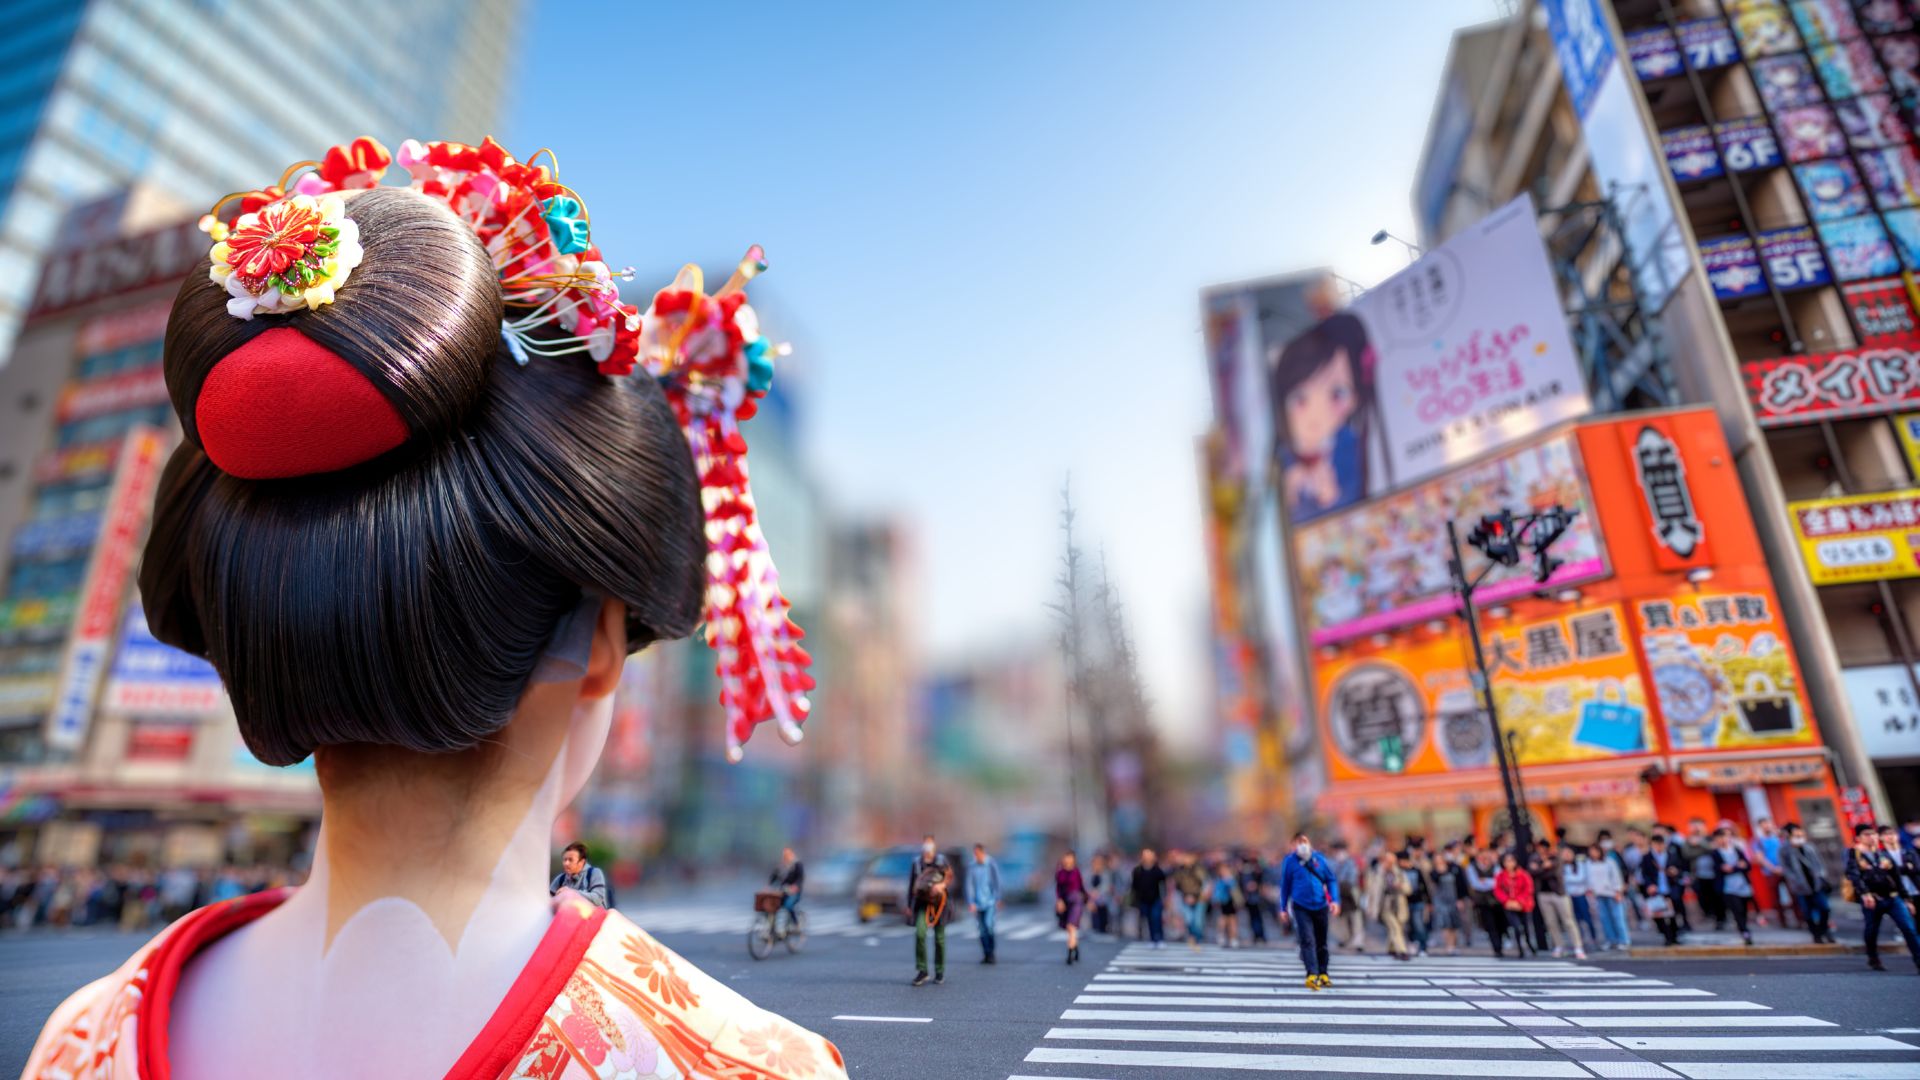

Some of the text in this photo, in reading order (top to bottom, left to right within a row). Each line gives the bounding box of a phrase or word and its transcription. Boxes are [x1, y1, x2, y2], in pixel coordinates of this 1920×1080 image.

[1686, 39, 1736, 69] 7F
[1726, 137, 1777, 170] 6F
[1769, 252, 1824, 286] 5F
[1766, 354, 1920, 409] メイド
[1804, 501, 1920, 535] 全身もみほ
[1484, 611, 1622, 672] 大黒屋
